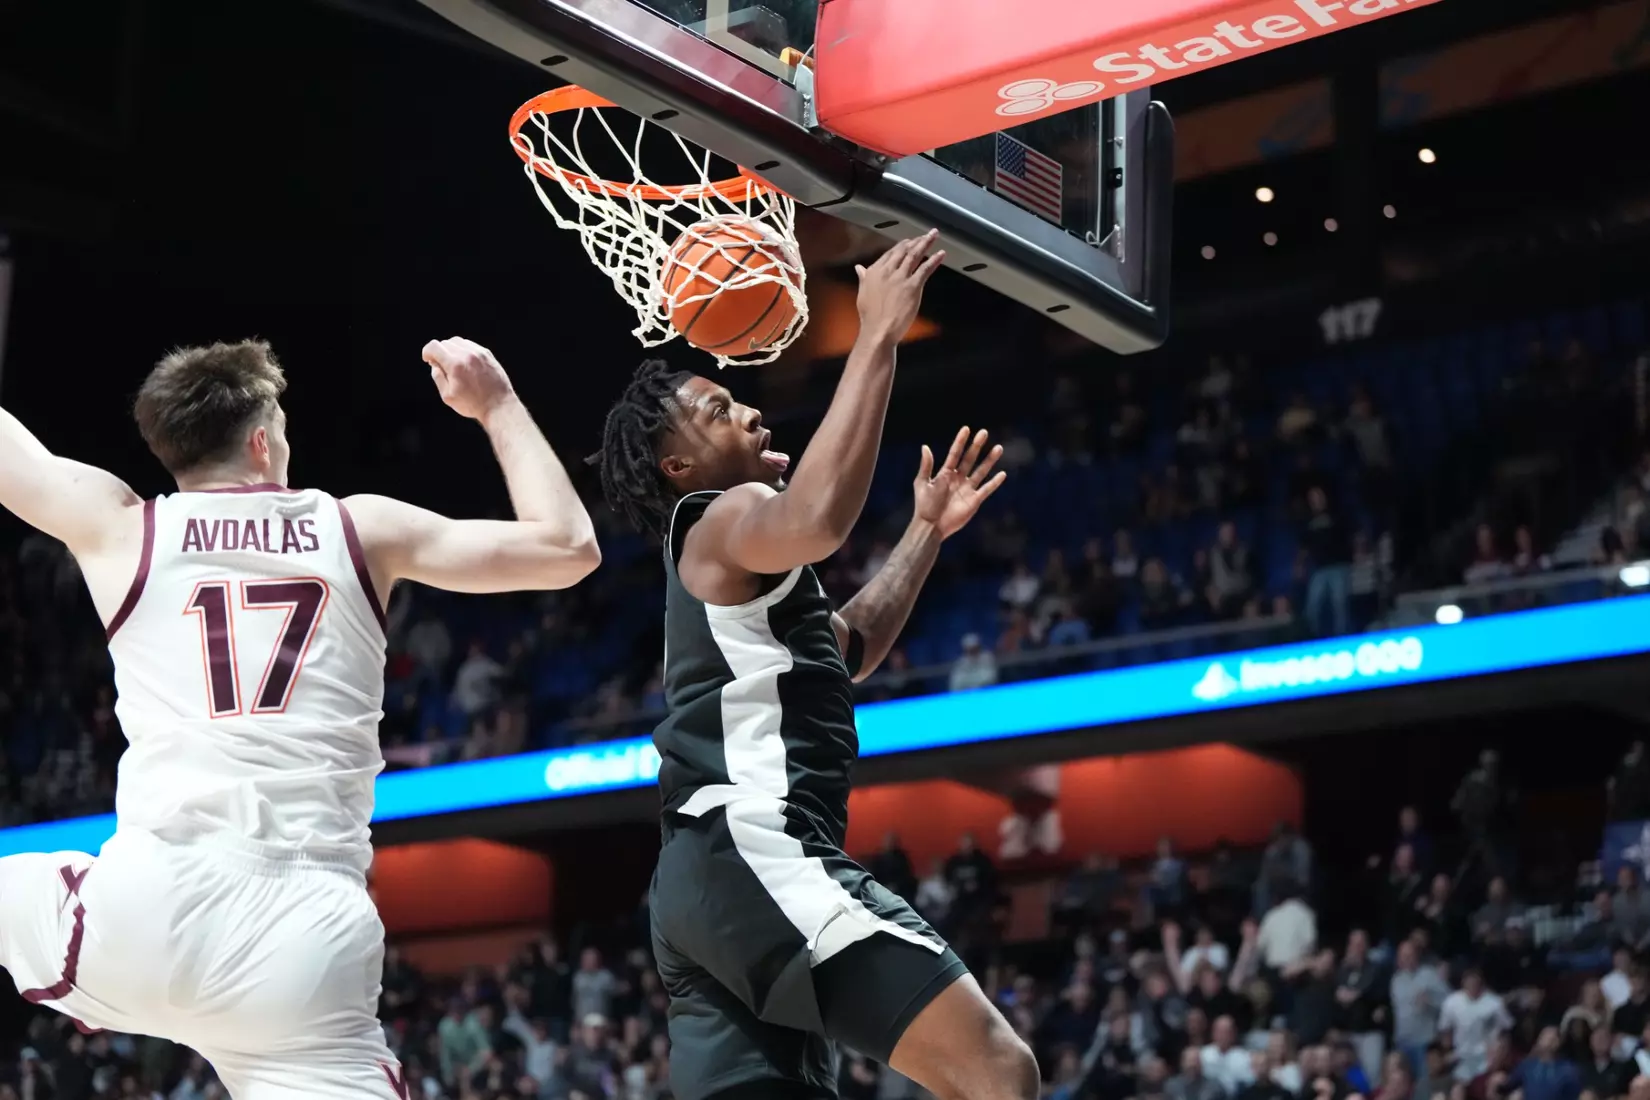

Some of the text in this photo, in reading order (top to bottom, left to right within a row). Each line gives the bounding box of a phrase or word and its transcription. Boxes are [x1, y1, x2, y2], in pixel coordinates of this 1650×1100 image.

[1319, 298, 1382, 344] 117
[182, 518, 320, 554] AVDALAS
[182, 576, 330, 719] 17
